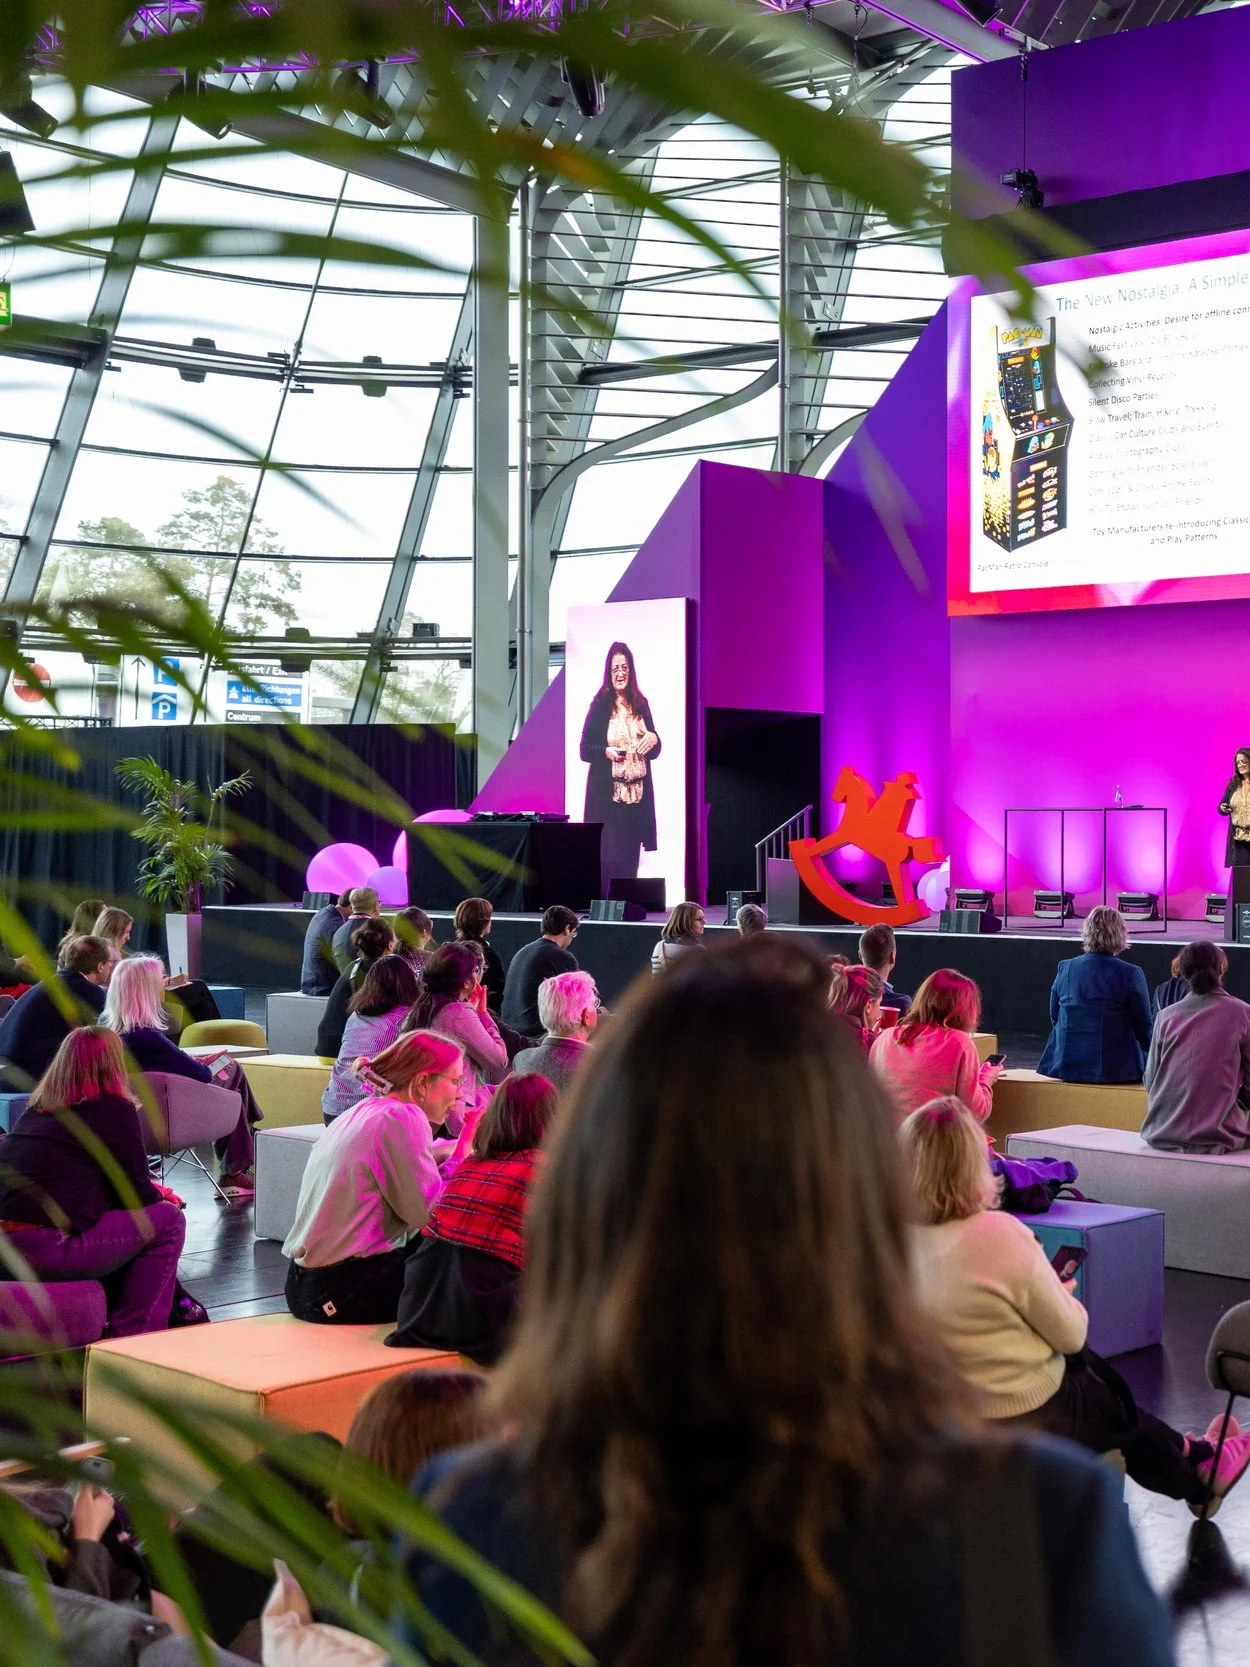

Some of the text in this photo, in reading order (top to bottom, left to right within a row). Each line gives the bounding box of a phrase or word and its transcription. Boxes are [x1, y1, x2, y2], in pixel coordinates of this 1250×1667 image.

[1056, 296, 1080, 311] The
[1084, 293, 1112, 306] New
[1188, 277, 1198, 291] A
[1164, 313, 1190, 325] Desire
[1191, 312, 1203, 321] for
[1205, 307, 1231, 319] offline
[1088, 344, 1110, 354] Music
[1120, 358, 1137, 368] Bars
[1088, 377, 1125, 389] Collecting
[1089, 397, 1110, 406] Silent
[1111, 394, 1131, 404] Disco
[1089, 415, 1106, 425] Sow
[1107, 410, 1132, 423] Travel;
[1129, 426, 1157, 439] Culture
[1093, 528, 1105, 536] Toy
[1107, 523, 1164, 534] Manufacturers
[1223, 516, 1249, 526] Classic
[1150, 532, 1218, 545] and Play Patterns
[241, 694, 293, 705] all directions
[158, 702, 171, 720] P
[227, 711, 261, 721] Centrum
